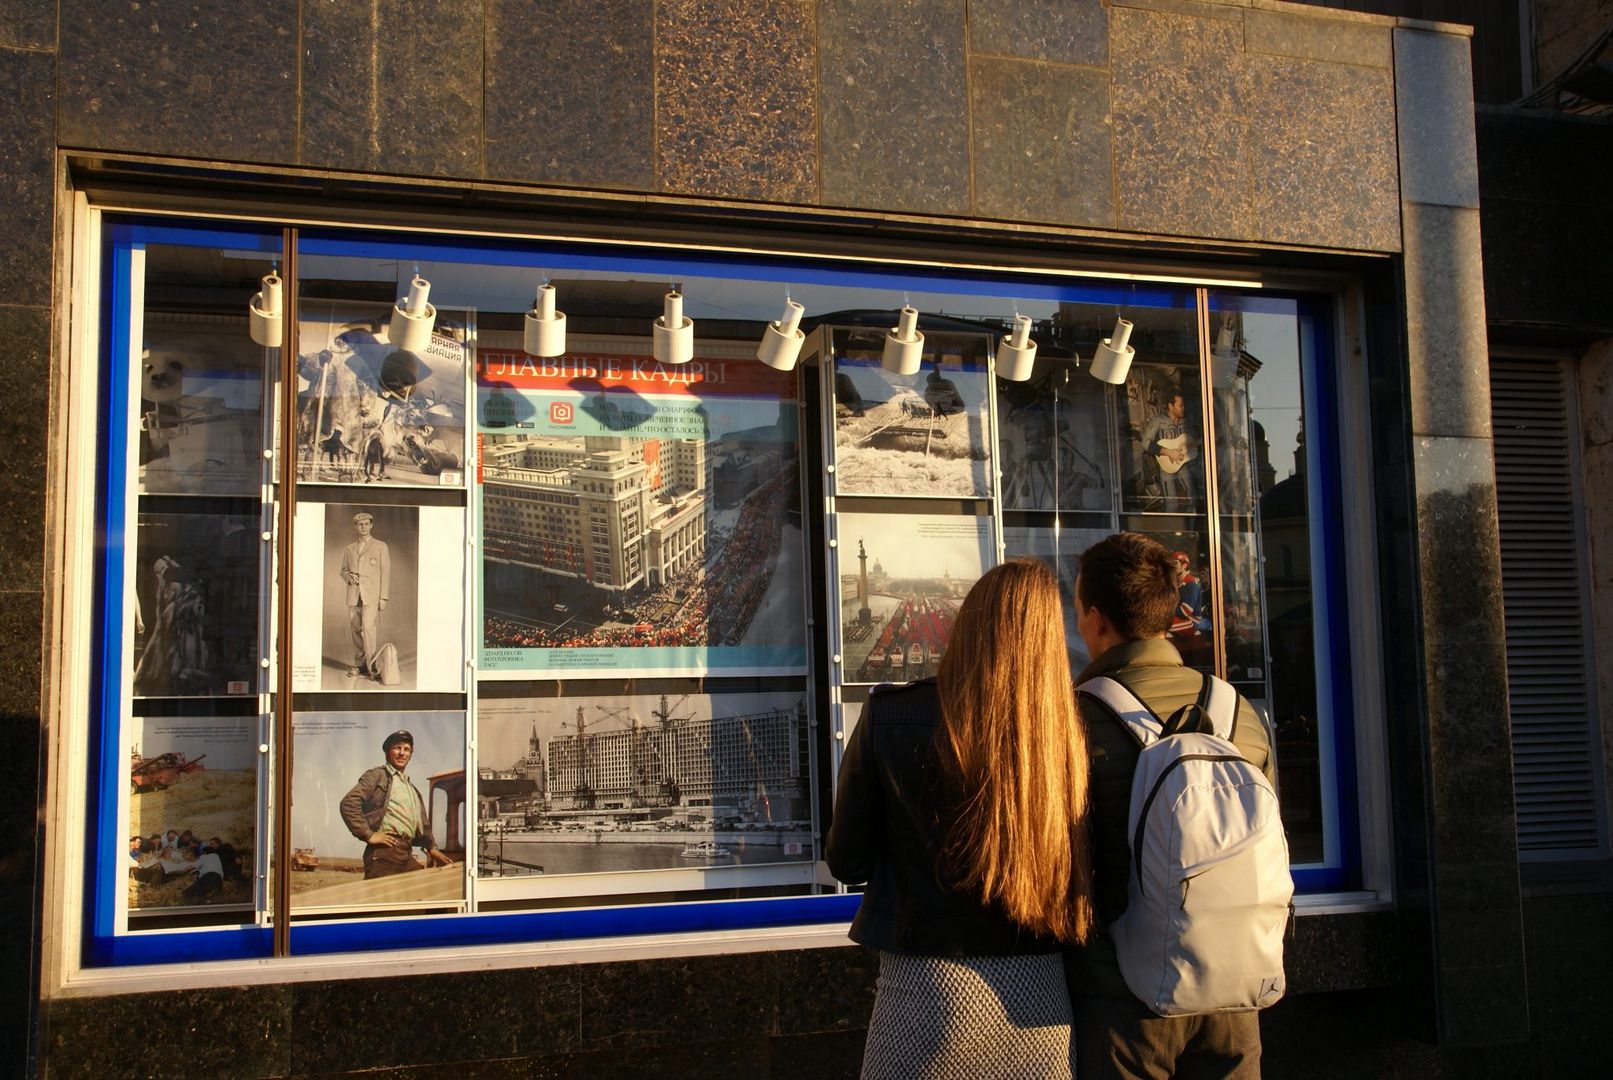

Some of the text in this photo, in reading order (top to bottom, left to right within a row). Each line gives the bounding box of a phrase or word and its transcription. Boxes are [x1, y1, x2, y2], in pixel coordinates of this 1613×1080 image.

[431, 337, 460, 352] ЯРНАЯ
[424, 345, 462, 362] ВИАЦИЯ
[483, 352, 728, 386] ГЛАВНЫЕ КАДРЫ
